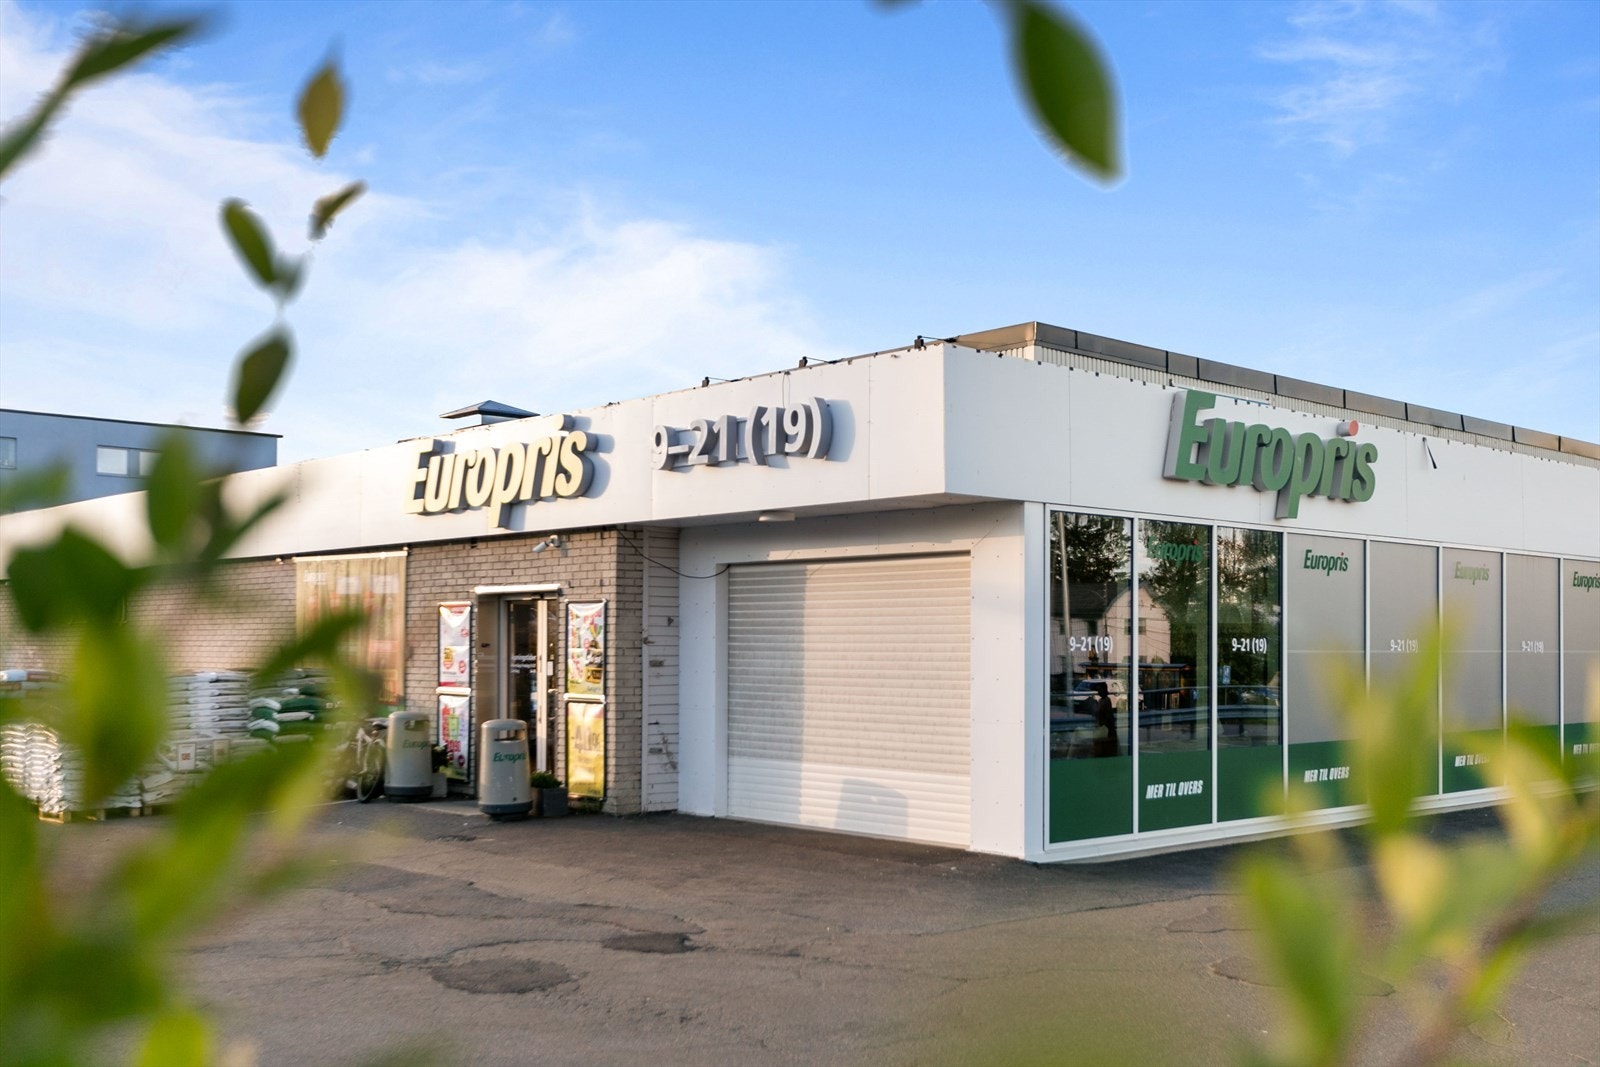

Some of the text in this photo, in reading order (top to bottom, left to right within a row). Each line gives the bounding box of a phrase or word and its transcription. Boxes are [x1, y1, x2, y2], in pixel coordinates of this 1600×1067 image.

[745, 396, 832, 466] (19)
[1163, 389, 1378, 519] Europris
[403, 413, 597, 528] Europris
[1147, 534, 1203, 568] Europris
[1303, 549, 1349, 576] Europris
[1454, 561, 1490, 585] Europris
[1094, 635, 1114, 654] (19)
[1251, 637, 1267, 654] (19)
[1455, 755, 1466, 767] MER
[1304, 766, 1350, 783] MER TIL OVERS
[1146, 780, 1203, 799] MER TIL OVERS
